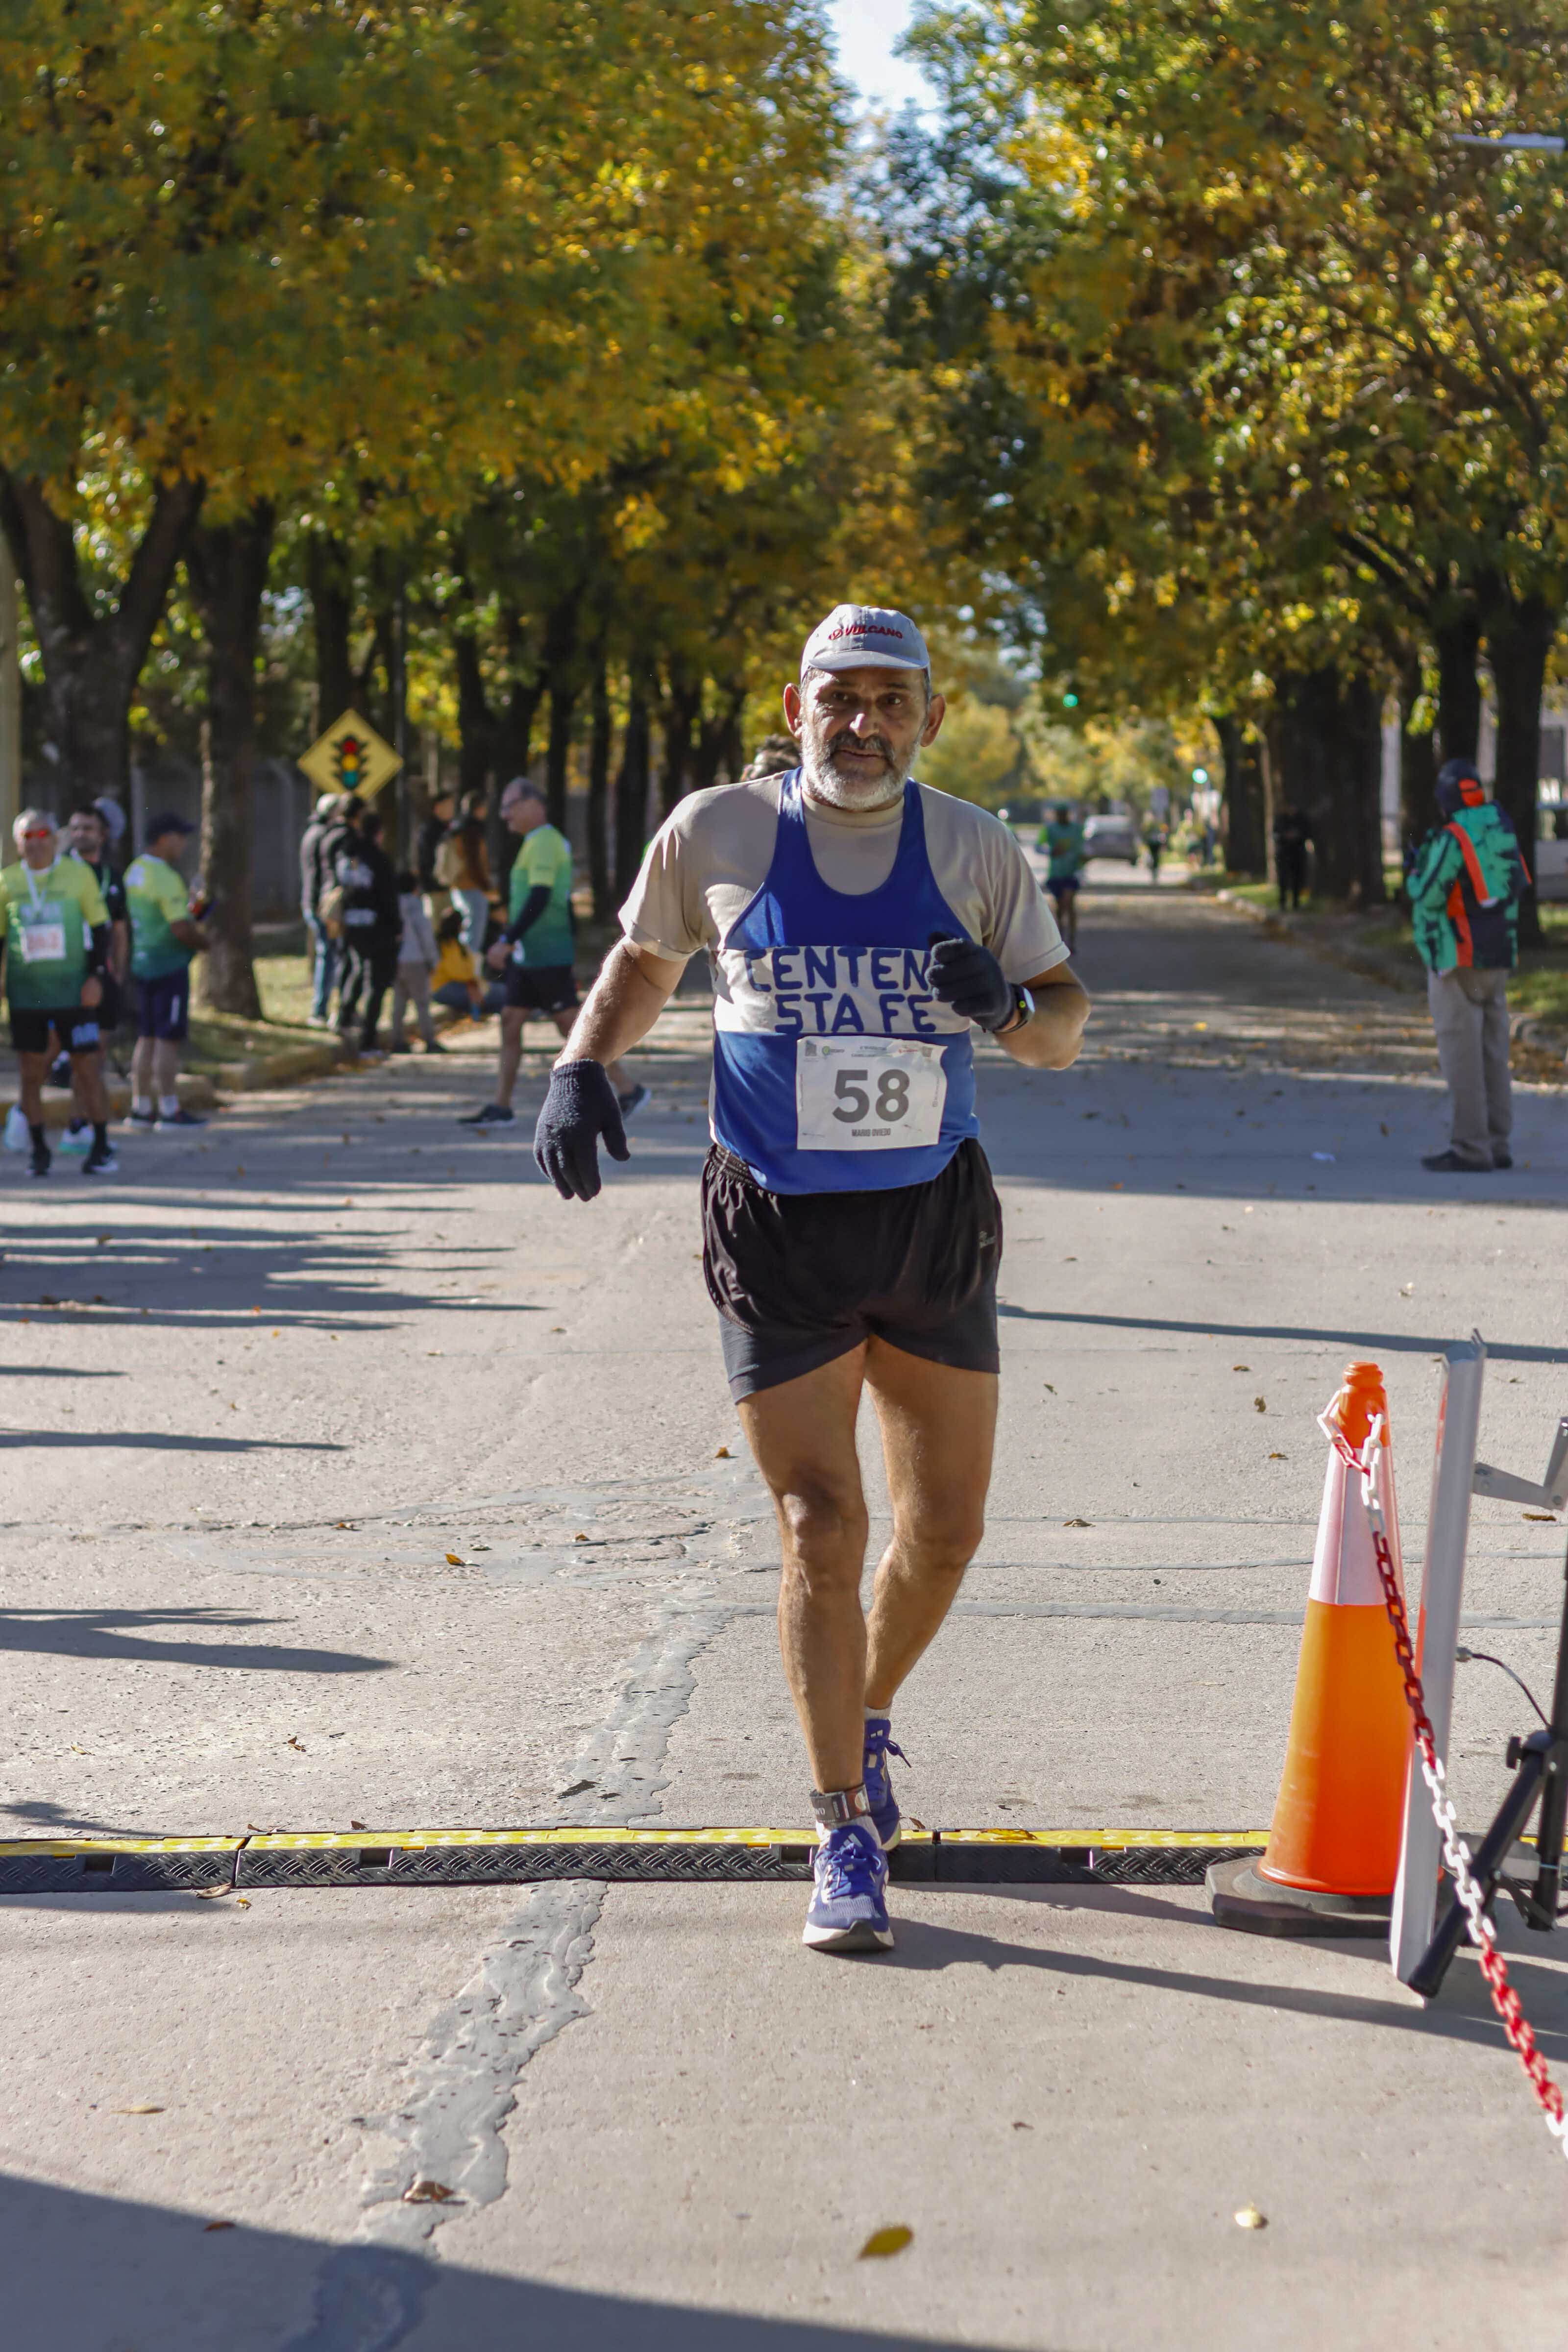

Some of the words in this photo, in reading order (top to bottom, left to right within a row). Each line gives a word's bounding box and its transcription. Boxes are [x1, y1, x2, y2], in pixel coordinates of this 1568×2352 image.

[846, 624, 903, 639] VULCANO
[744, 946, 940, 992] CENTEN
[775, 992, 864, 1033] STA
[879, 993, 936, 1033] FE
[832, 1069, 910, 1123] 58
